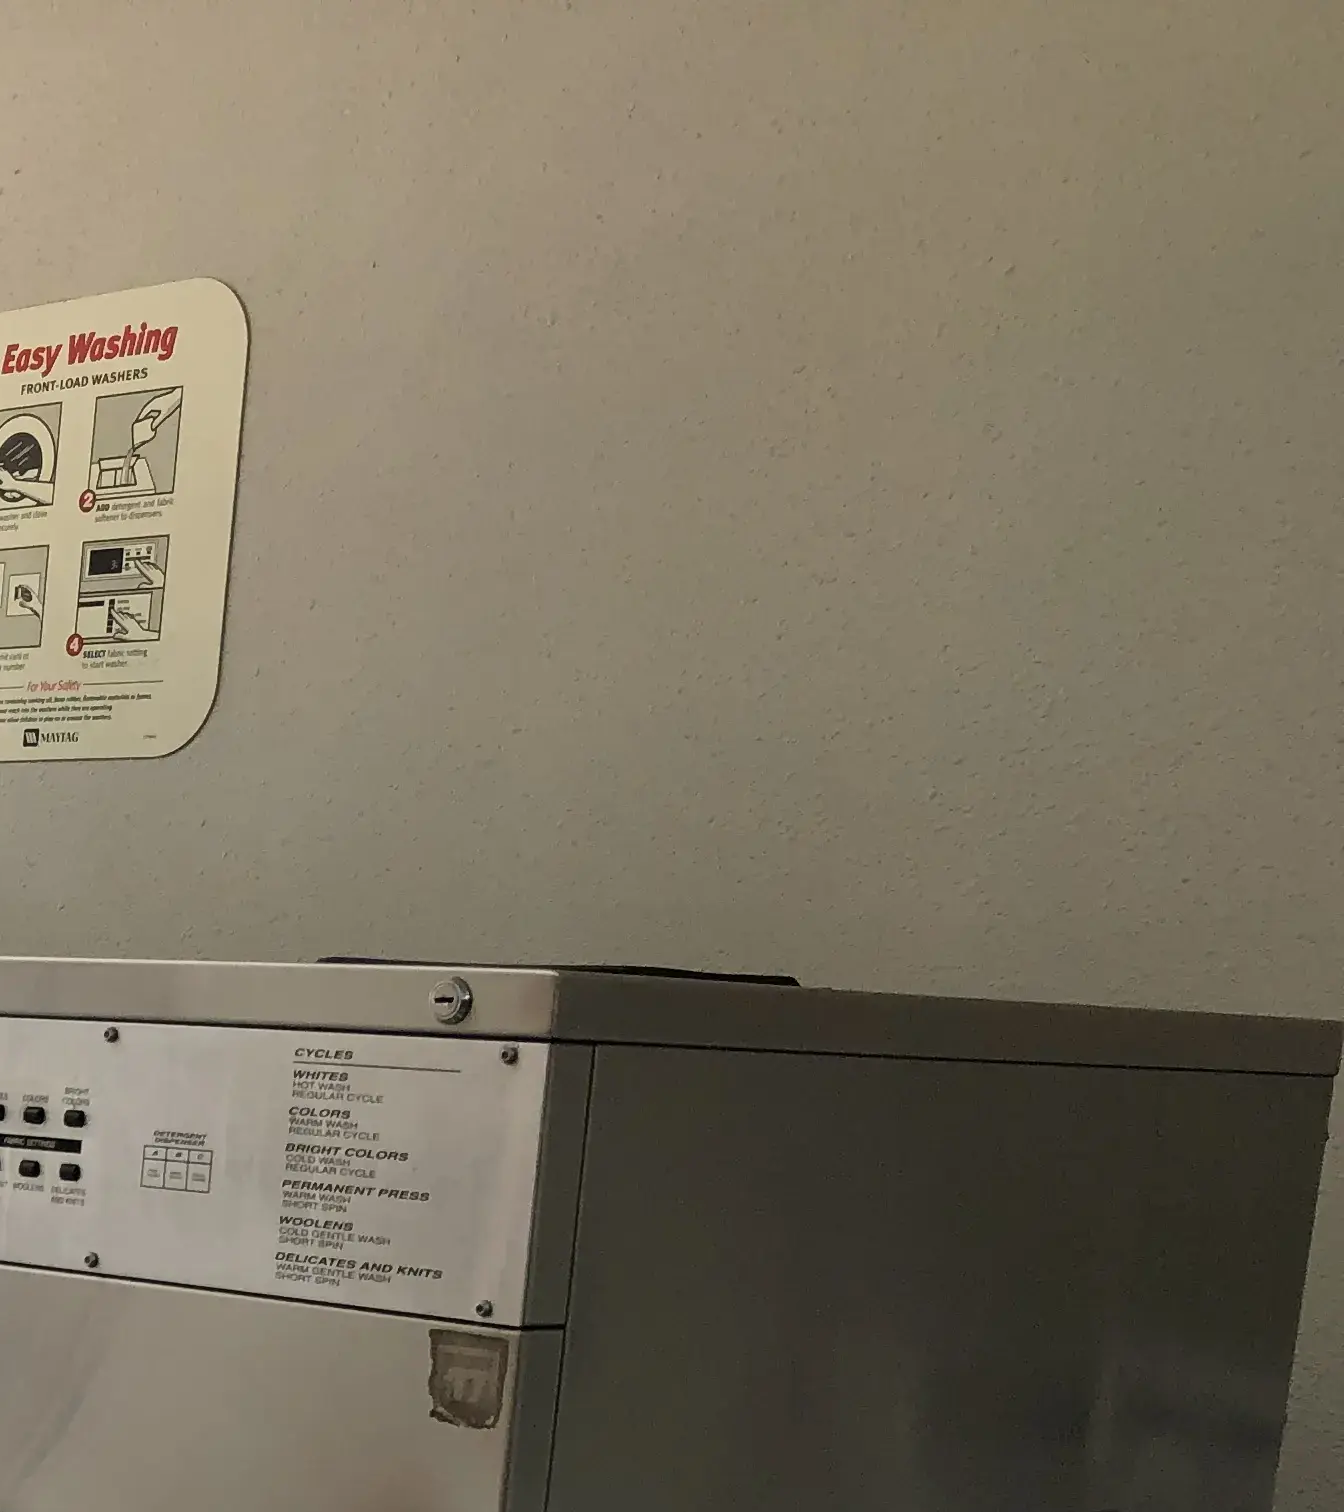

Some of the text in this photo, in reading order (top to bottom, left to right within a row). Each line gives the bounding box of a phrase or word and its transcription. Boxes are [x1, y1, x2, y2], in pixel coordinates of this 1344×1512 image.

[1, 322, 179, 378] Easy Washing
[20, 367, 149, 396] FRONT-LOAD WASHERS
[83, 650, 107, 659] SELECT
[38, 680, 58, 691] Your
[58, 680, 82, 691] Safety
[41, 732, 80, 744] MAYTAG
[294, 1048, 354, 1060] CYCLES
[292, 1069, 349, 1082] WHITES
[292, 1080, 351, 1092] HOT WASH
[346, 1093, 384, 1104] CYCLE
[288, 1105, 351, 1119] COLORS
[325, 1120, 359, 1130] WASH
[284, 1142, 410, 1162] BRIGHT COLORS
[318, 1157, 352, 1167] WASH
[339, 1167, 377, 1179] CYCLE
[282, 1178, 431, 1202] PERMANENT PRESS
[279, 1215, 354, 1232] WOOLENS
[275, 1251, 444, 1280] DELICATES AND KNITS
